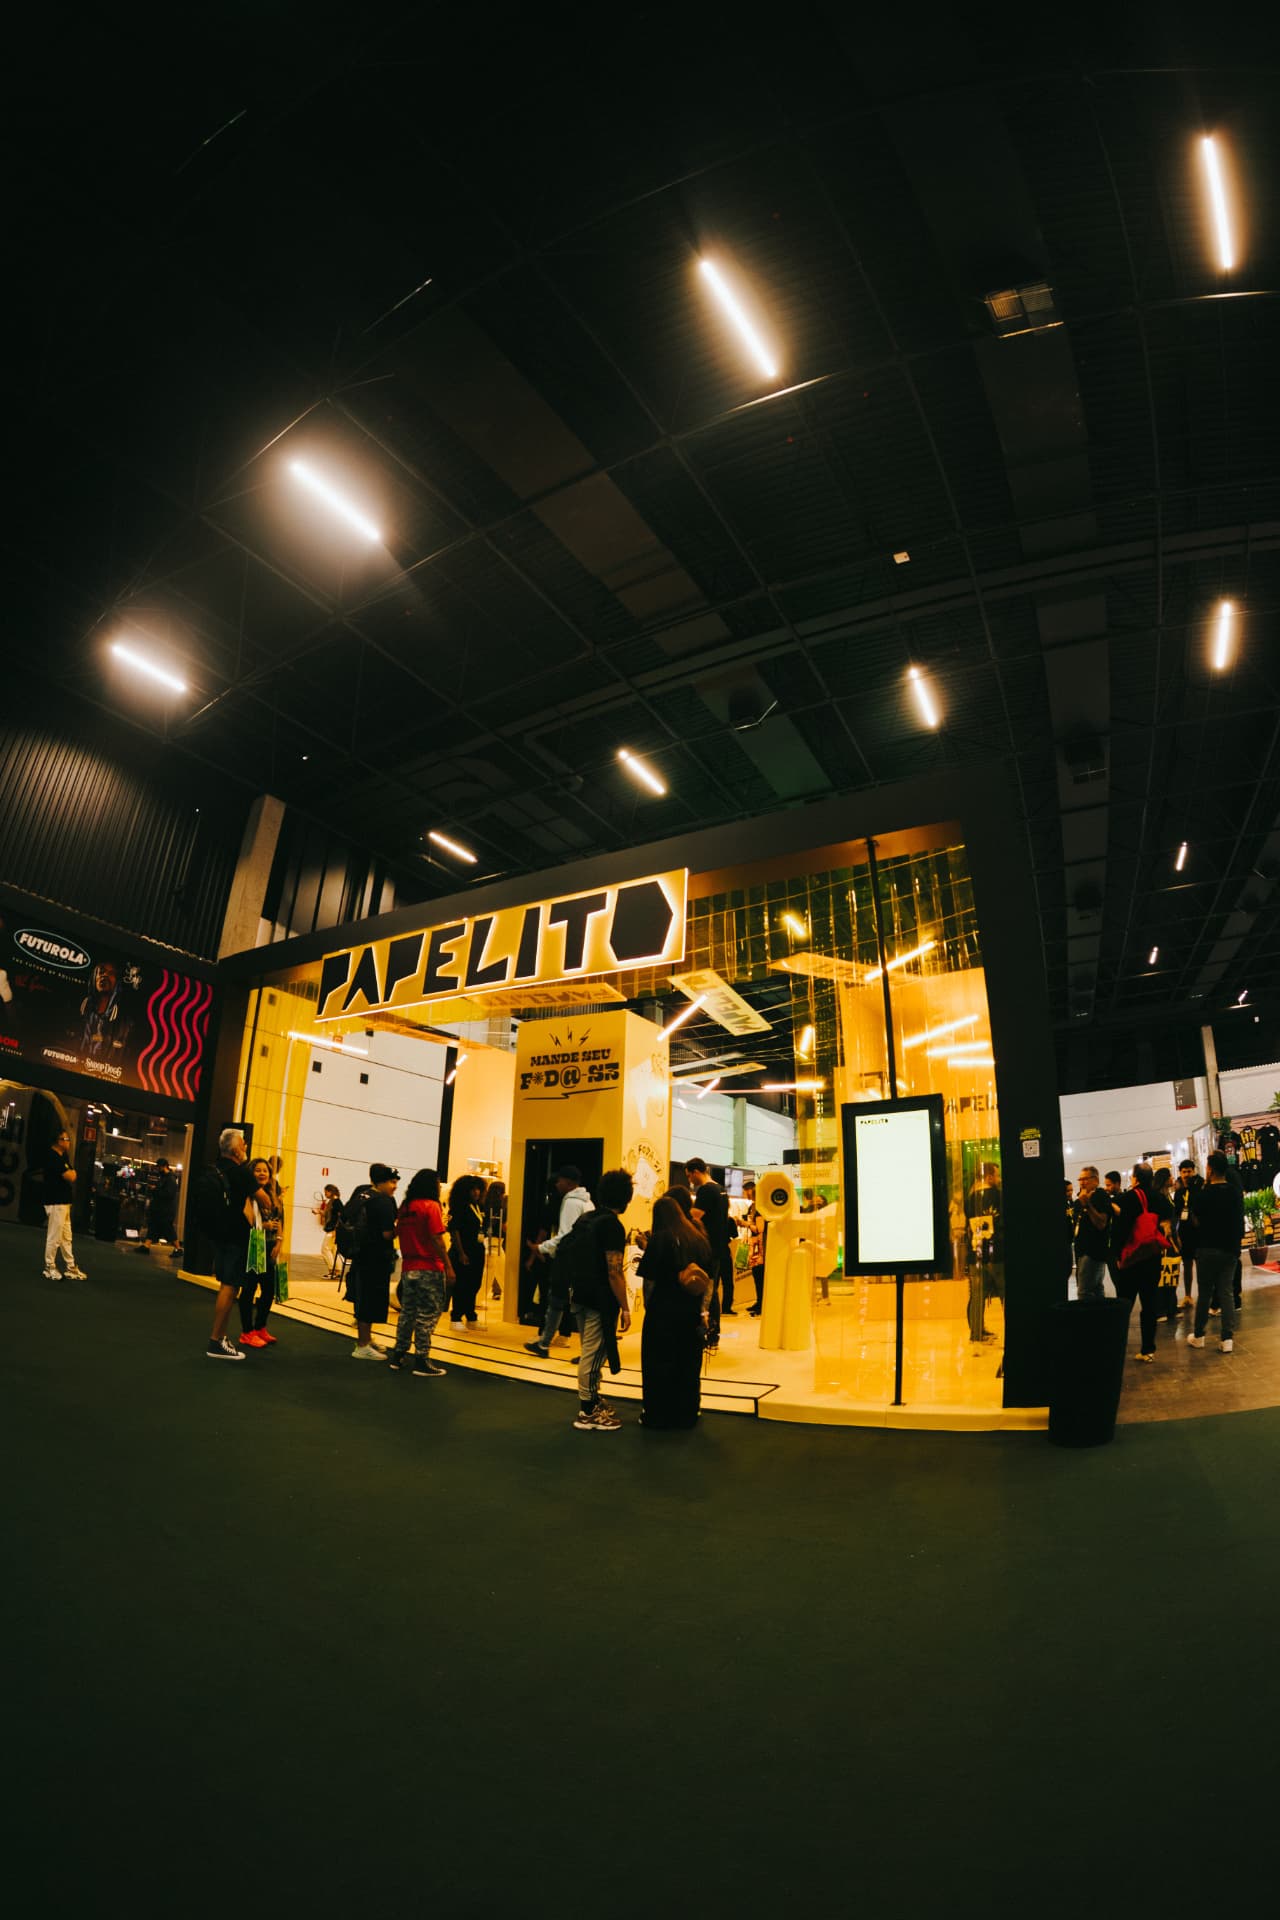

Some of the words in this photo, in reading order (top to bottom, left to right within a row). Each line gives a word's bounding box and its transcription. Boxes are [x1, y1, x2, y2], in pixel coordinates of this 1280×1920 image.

[19, 932, 85, 965] FUTUROLA
[317, 880, 675, 1016] PAPELITO
[530, 1051, 579, 1067] MANDE
[581, 1048, 611, 1062] SEU
